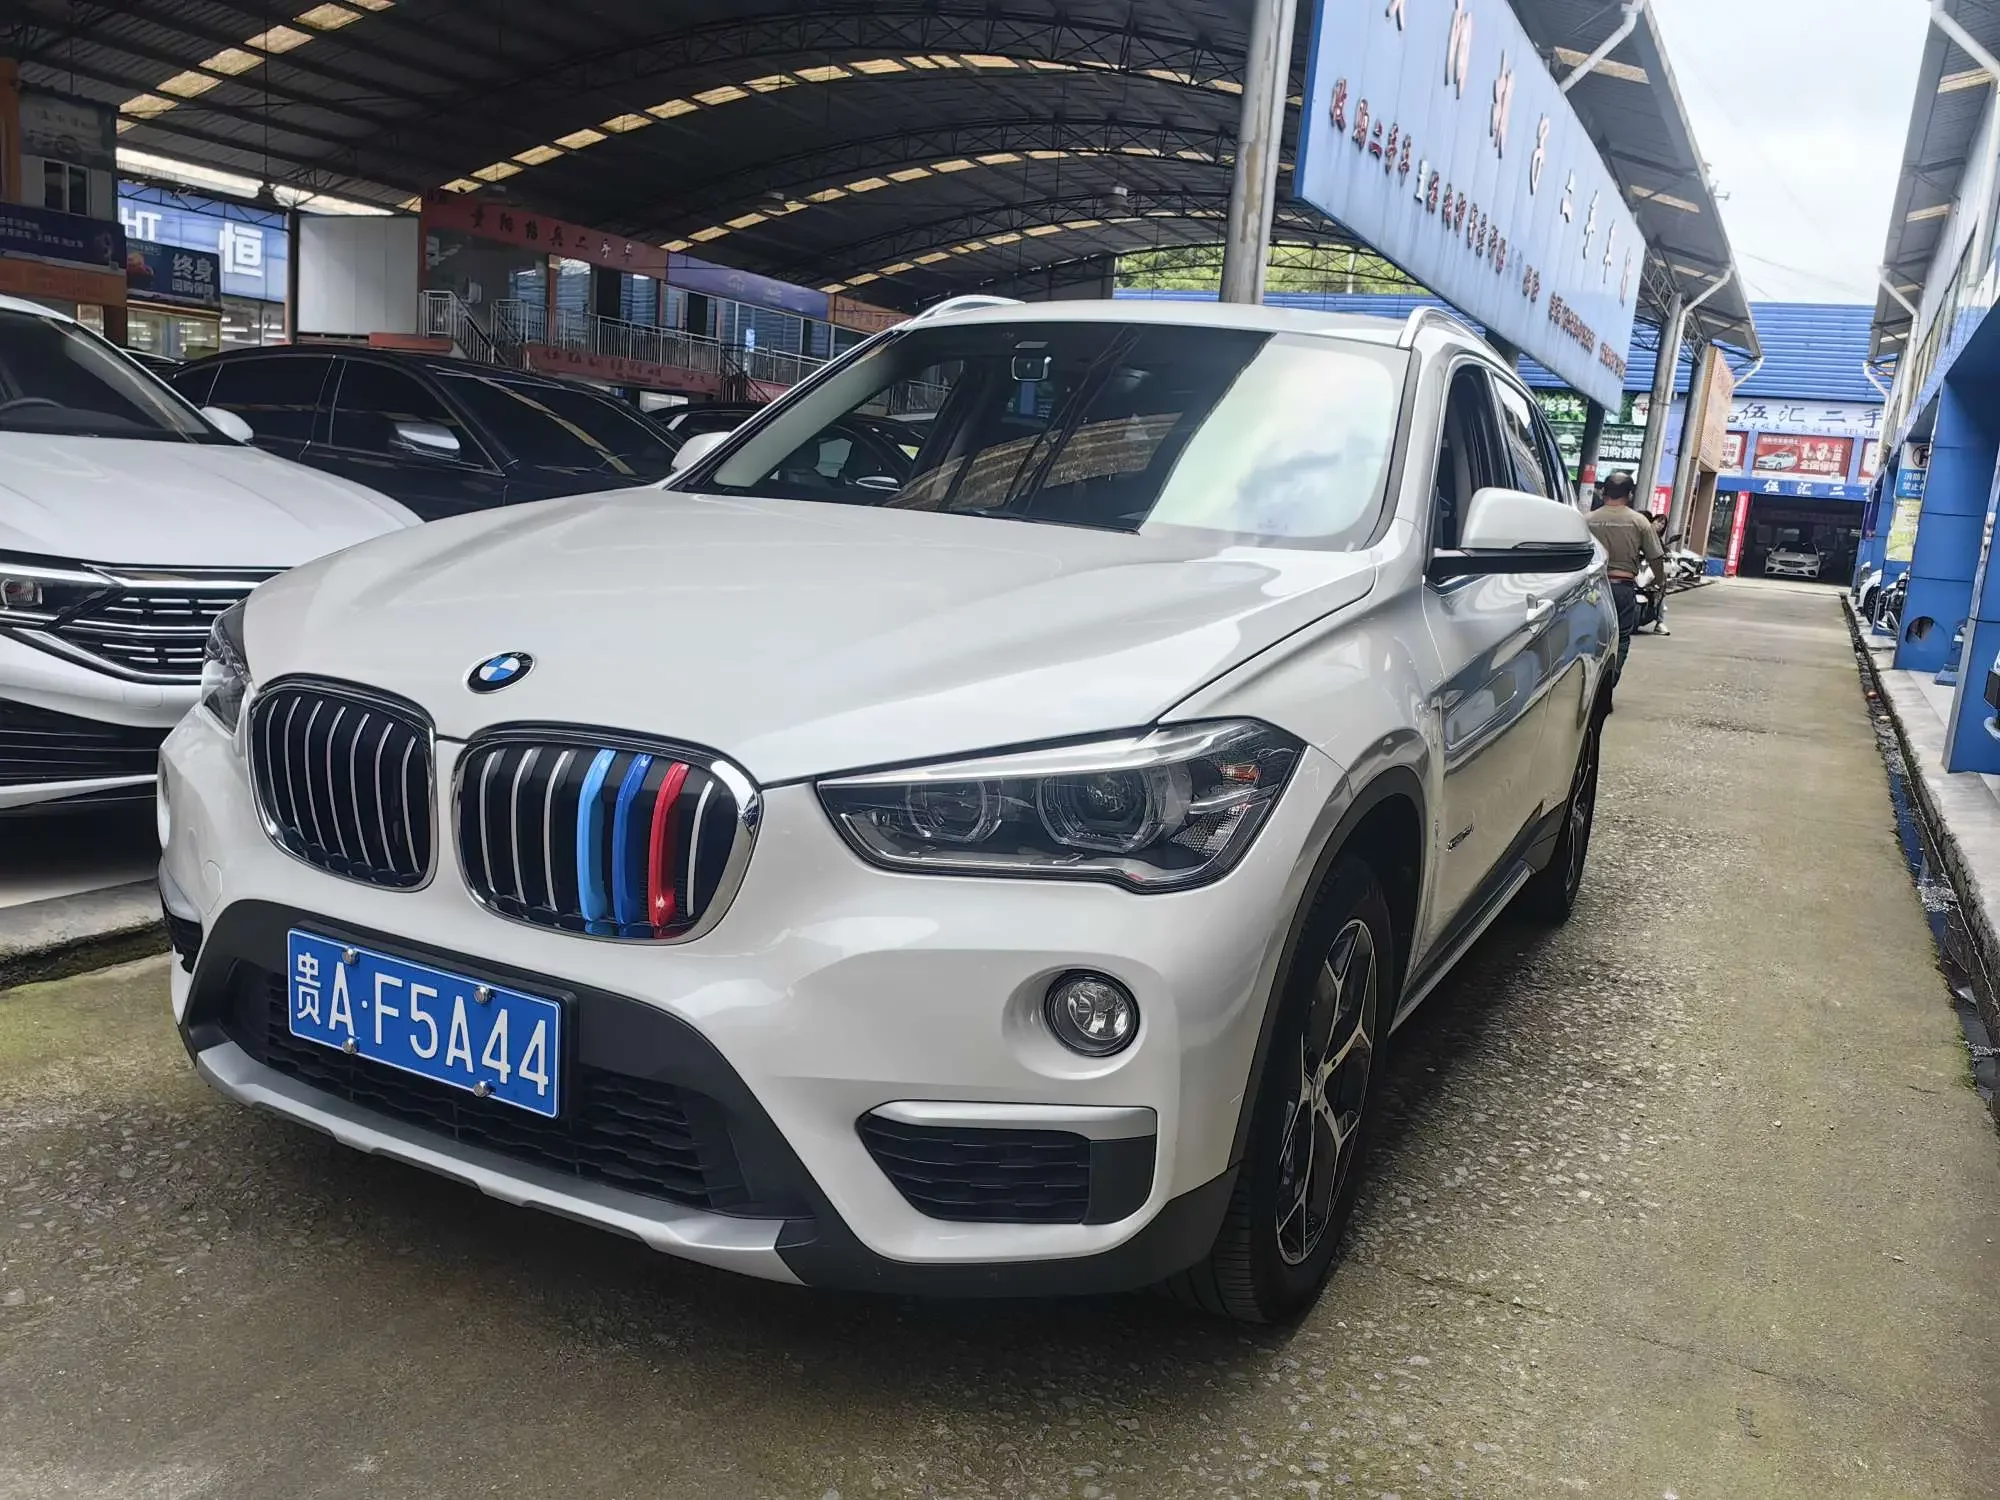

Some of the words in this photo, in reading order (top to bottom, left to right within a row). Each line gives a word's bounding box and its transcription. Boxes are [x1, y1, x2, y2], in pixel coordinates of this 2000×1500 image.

[171, 253, 213, 282] 终身
[219, 222, 263, 277] 恒
[1763, 480, 1869, 498] 伍汇二
[295, 952, 549, 1097] 贵A·F5A44
